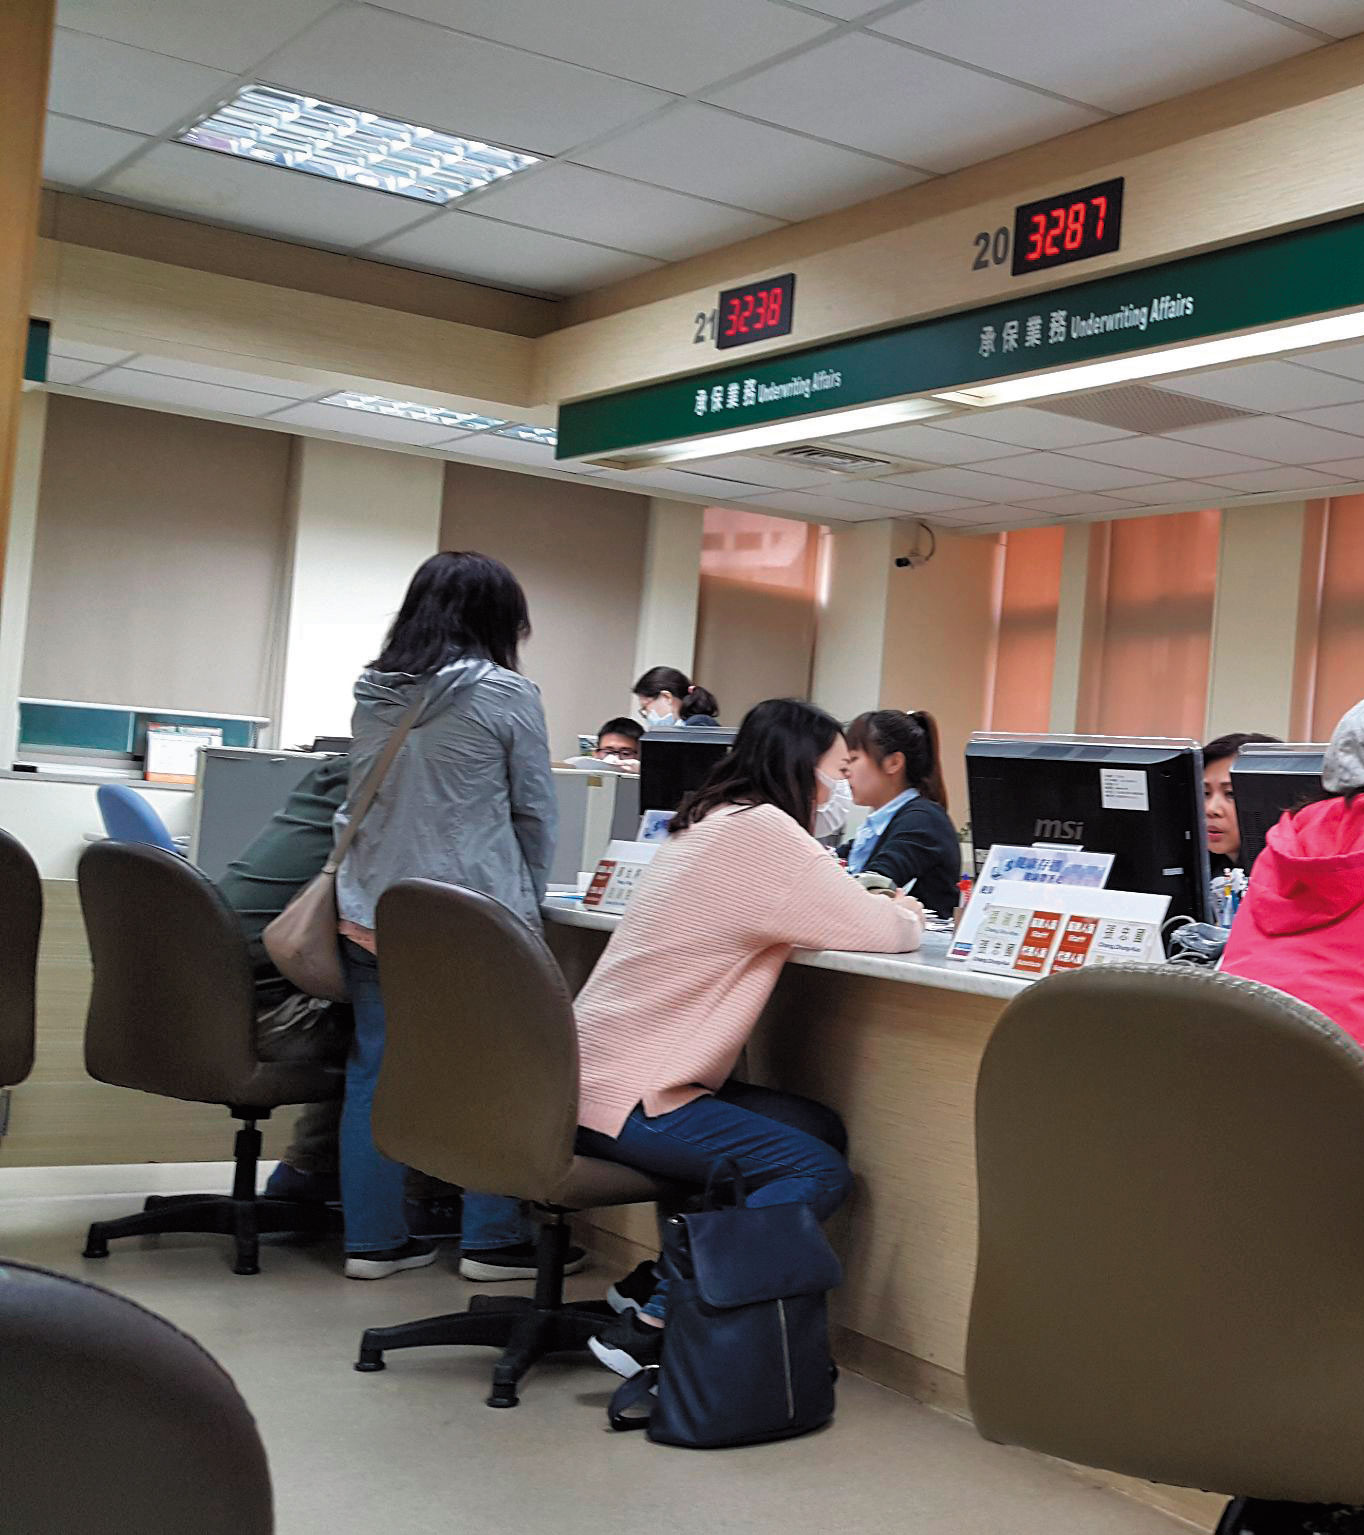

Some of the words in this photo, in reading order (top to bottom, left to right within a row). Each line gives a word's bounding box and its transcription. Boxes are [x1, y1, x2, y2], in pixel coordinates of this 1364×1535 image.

[972, 225, 1010, 272] 20
[1024, 195, 1108, 262] 3287
[693, 308, 718, 344] 21
[723, 287, 783, 337] 3238
[978, 308, 1069, 358] 承保業務
[1070, 304, 1149, 339] Underwriting
[1149, 293, 1195, 323] Affairs
[694, 378, 758, 417] 承保業務
[757, 376, 812, 403] Underwriting
[812, 368, 842, 393] Affairs
[1034, 818, 1085, 841] msi
